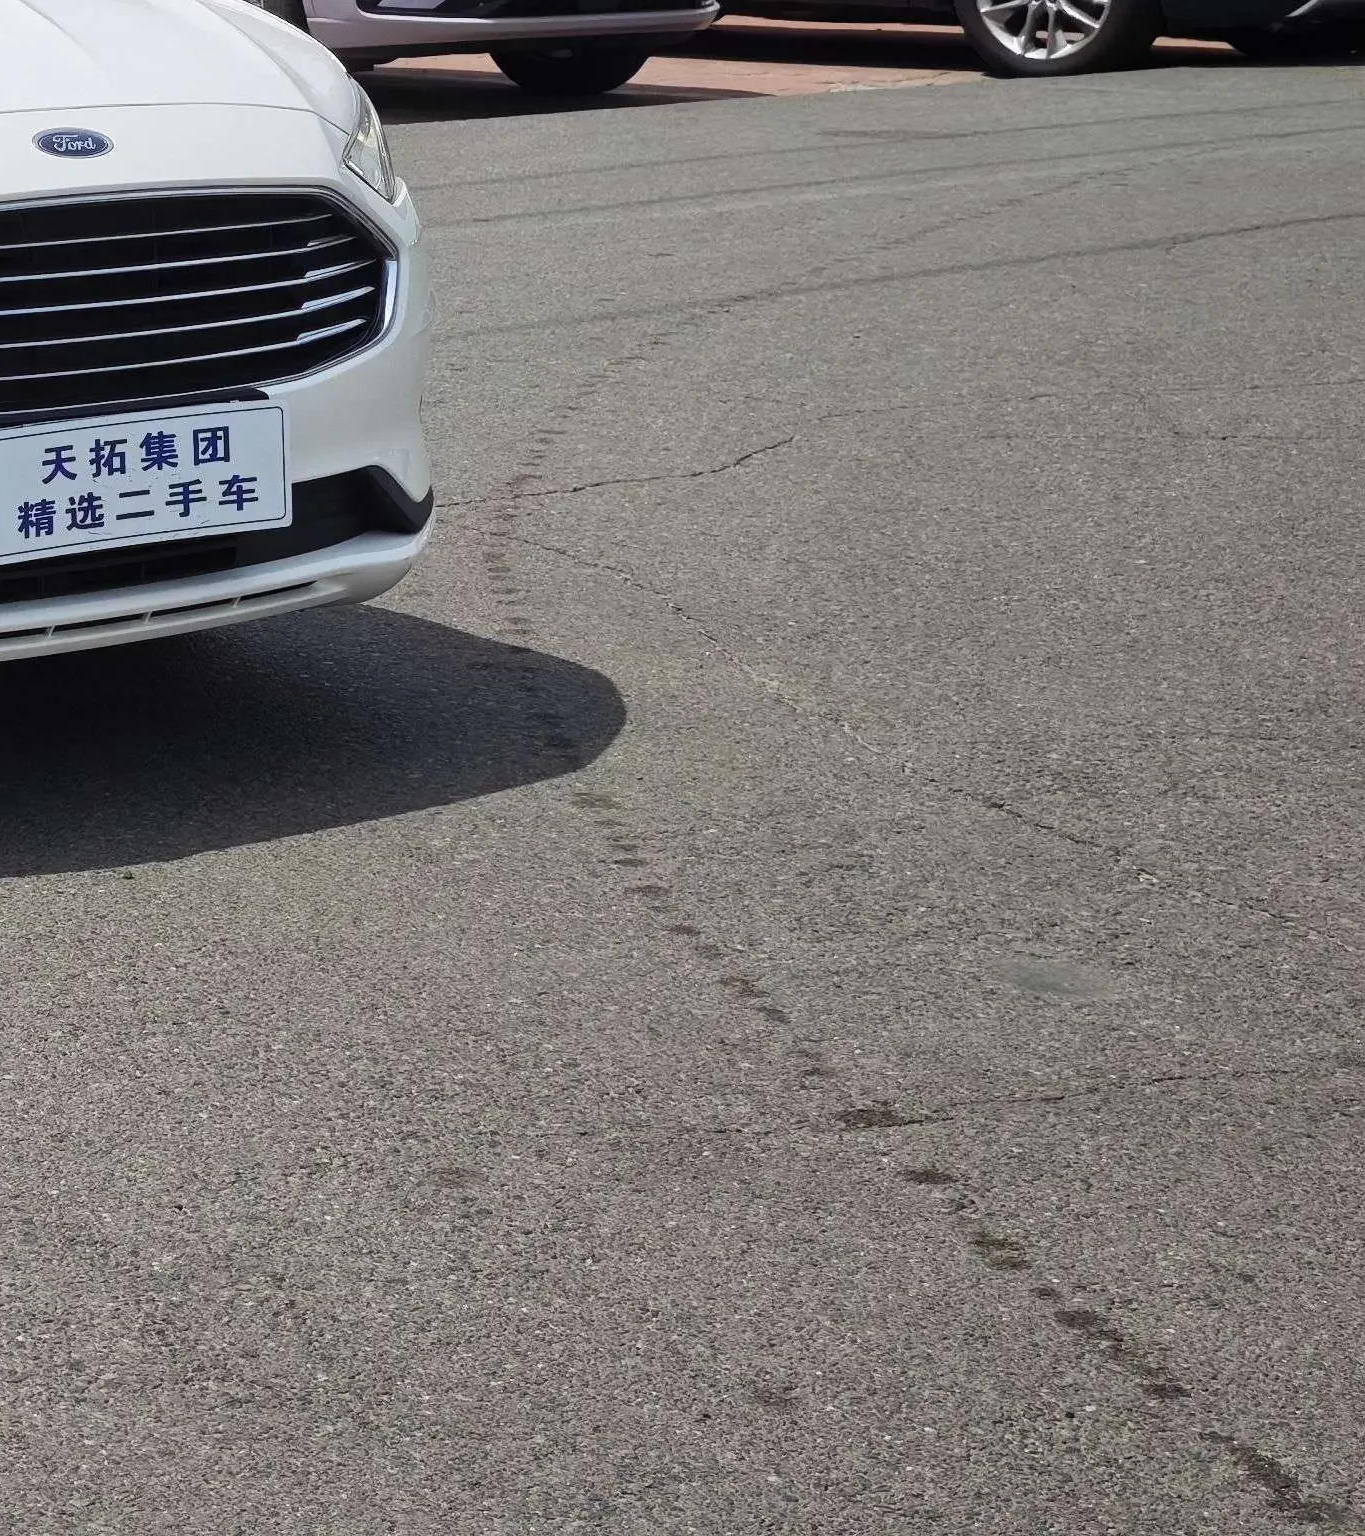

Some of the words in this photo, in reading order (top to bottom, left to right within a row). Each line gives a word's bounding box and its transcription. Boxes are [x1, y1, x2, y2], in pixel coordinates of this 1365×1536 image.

[52, 134, 97, 152] Ford
[41, 425, 232, 486] 天拓集团
[17, 474, 260, 540] 精选二手车
